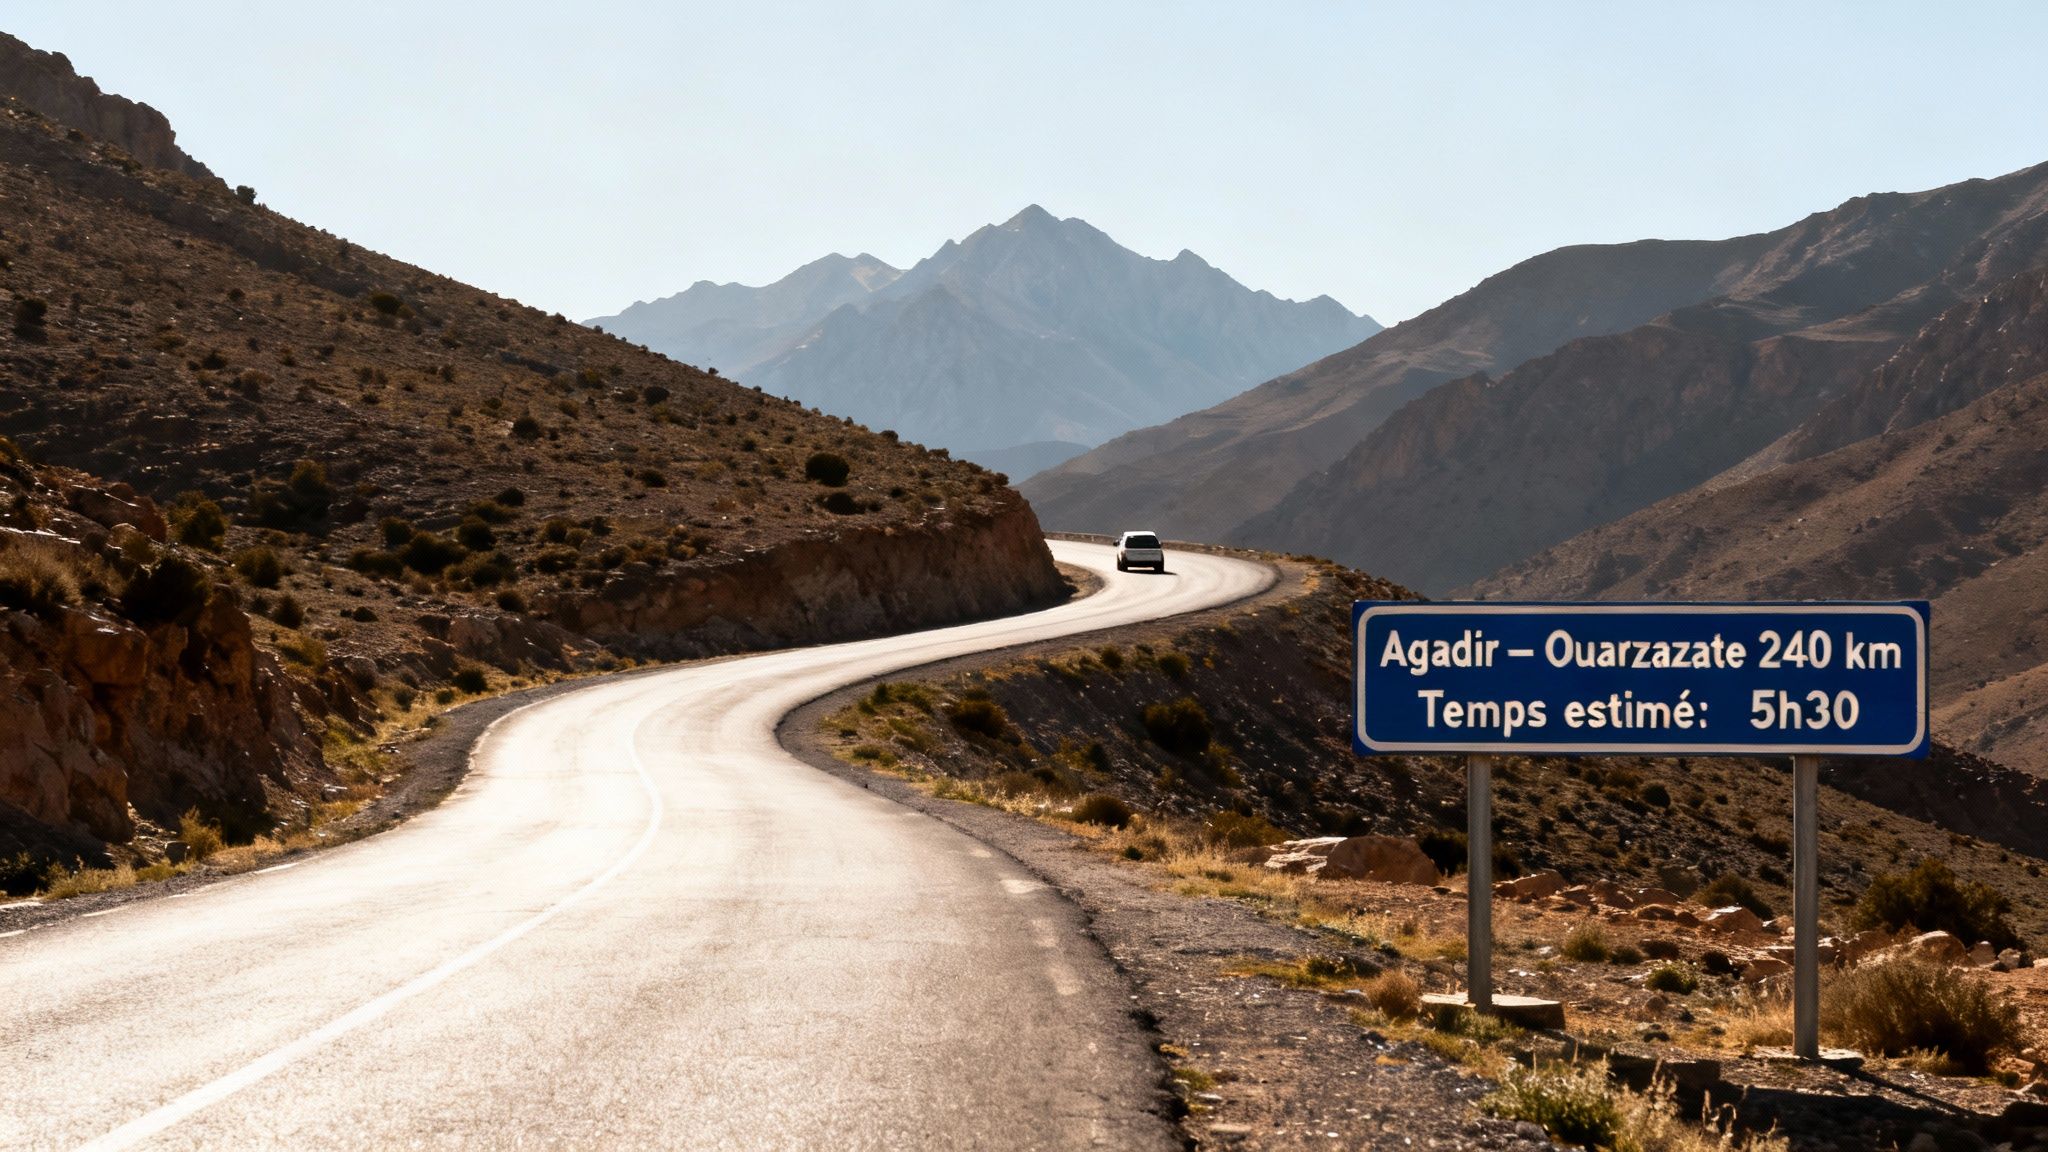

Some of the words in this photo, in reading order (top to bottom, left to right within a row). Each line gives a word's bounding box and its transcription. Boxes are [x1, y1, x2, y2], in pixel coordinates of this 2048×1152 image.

[1380, 629, 1500, 677] Agadir
[1544, 629, 1747, 670] Ouarzazate
[1758, 629, 1833, 670] 240
[1845, 631, 1902, 670] km
[1417, 688, 1548, 739] Temps
[1563, 688, 1709, 730] estimé:
[1749, 688, 1861, 731] 5h30
